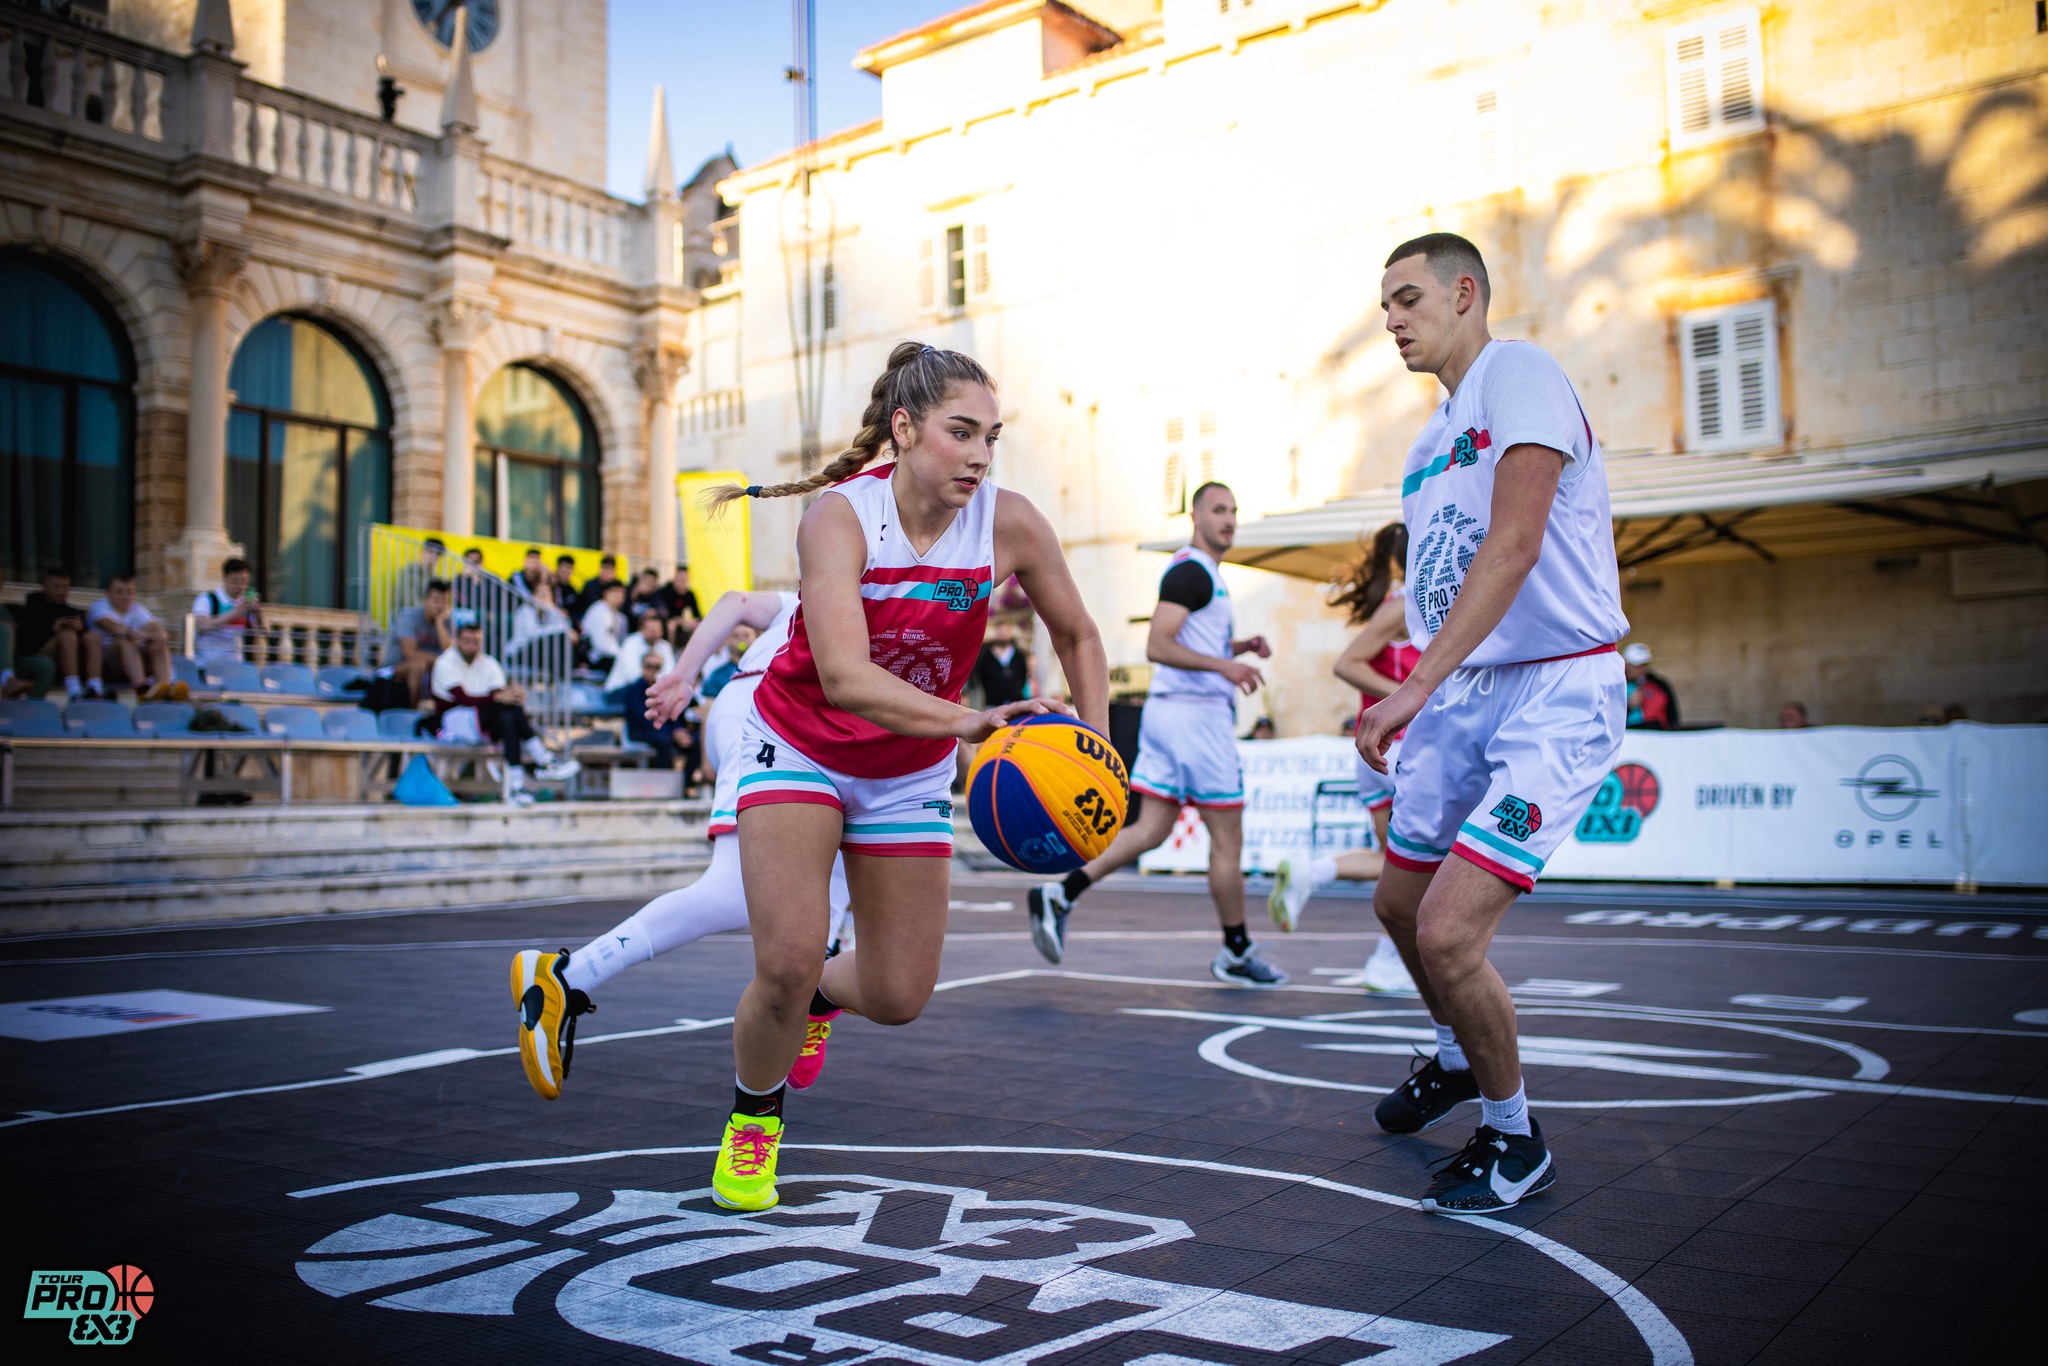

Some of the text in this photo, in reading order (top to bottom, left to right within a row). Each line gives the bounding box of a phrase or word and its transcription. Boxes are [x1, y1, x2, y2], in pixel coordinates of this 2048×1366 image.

[937, 586, 962, 597] PRO
[1428, 588, 1449, 611] PRO
[949, 597, 971, 609] 3X3
[902, 632, 926, 641] DUNKS
[907, 673, 931, 686] 3X3
[756, 742, 776, 769] 4
[1696, 783, 1797, 809] DRIVEN BY
[1074, 787, 1117, 836] 3X3
[1496, 801, 1527, 821] PRO
[1501, 818, 1530, 838] 3X3
[1834, 829, 1944, 849] OPEL
[1564, 909, 2048, 940] UDIPRO
